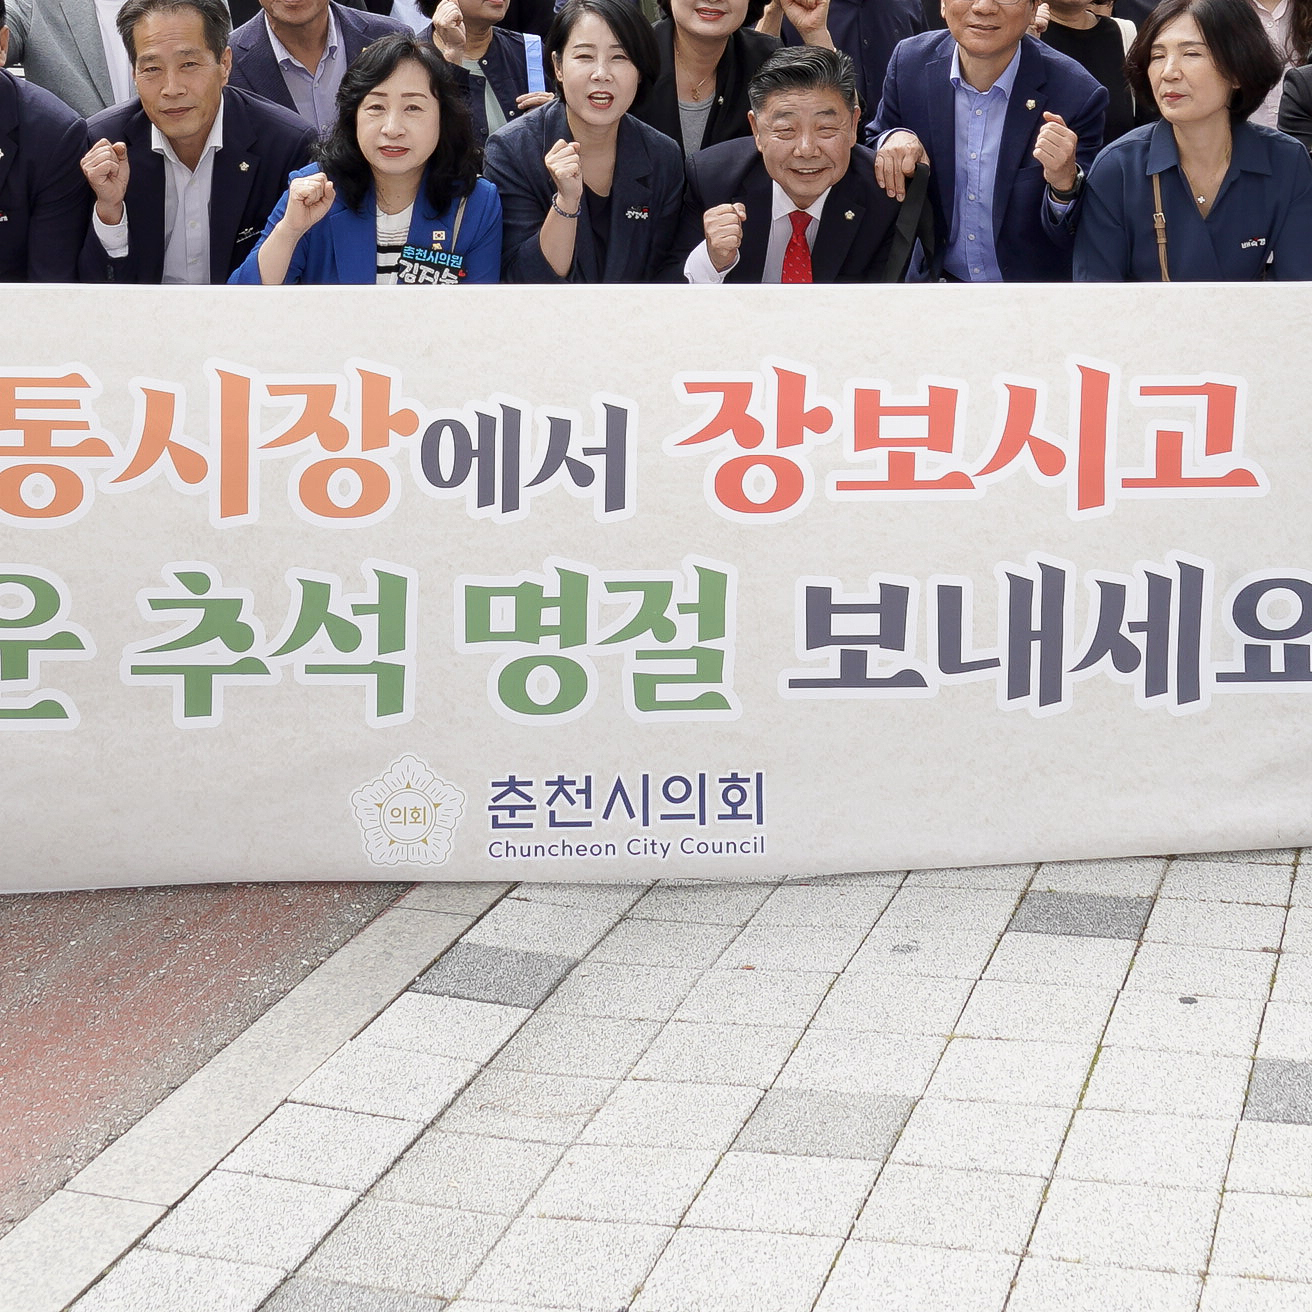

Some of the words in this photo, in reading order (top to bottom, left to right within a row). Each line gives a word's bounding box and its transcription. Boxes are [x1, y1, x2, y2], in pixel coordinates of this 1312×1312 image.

[402, 245, 464, 269] 춘천시의원
[673, 363, 1260, 514] 장보시고
[130, 567, 408, 719] 추석
[463, 564, 733, 716] 명절
[389, 804, 427, 827] 의회
[488, 771, 765, 830] 춘천시의회
[488, 839, 617, 860] Chuncheon
[626, 837, 671, 860] City
[679, 835, 766, 856] Council
